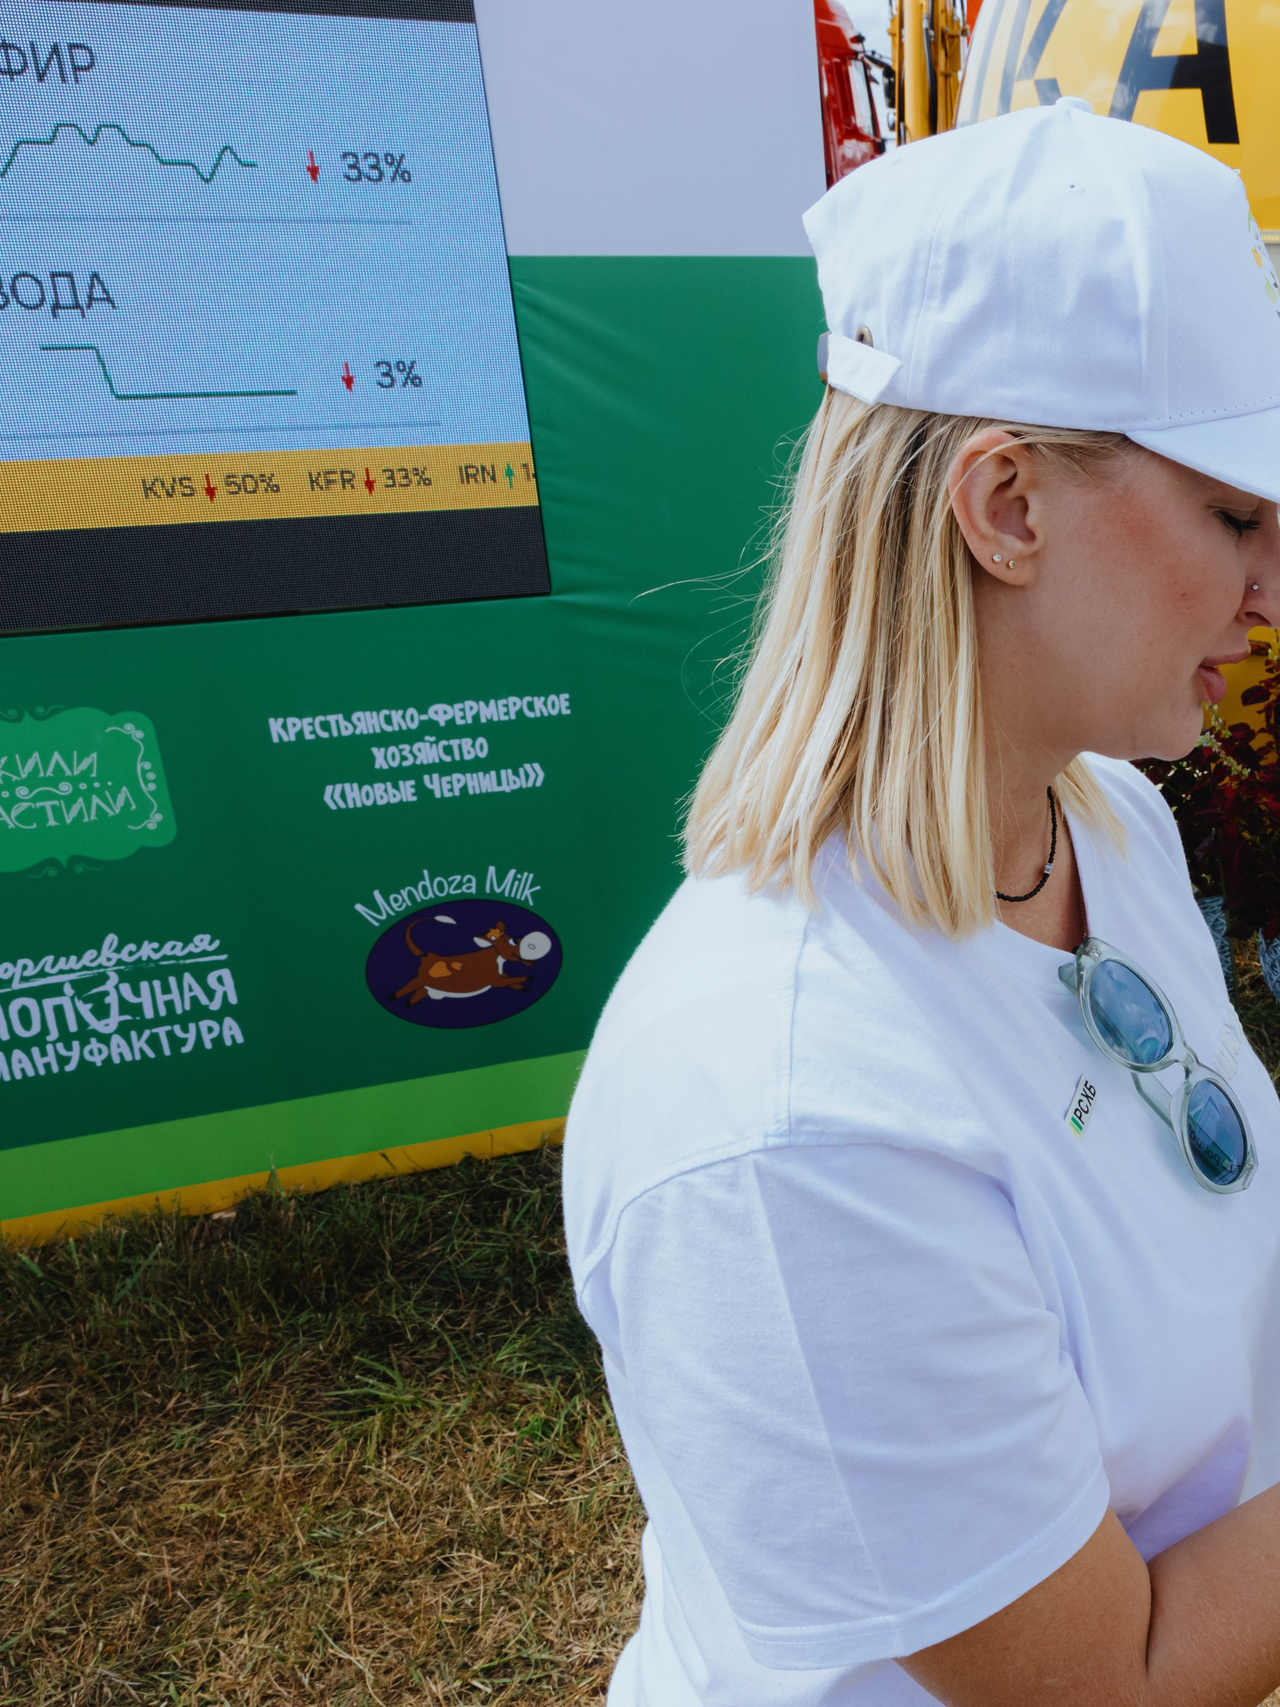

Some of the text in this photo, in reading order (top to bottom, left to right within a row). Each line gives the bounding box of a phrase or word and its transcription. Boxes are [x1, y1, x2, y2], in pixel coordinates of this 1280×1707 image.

[341, 151, 412, 184] 33%
[374, 360, 423, 389] 3%
[142, 477, 196, 500] KVS
[224, 473, 280, 497] 50%
[308, 469, 356, 492] KFR
[382, 466, 432, 488] 33%
[458, 463, 497, 484] IRN
[268, 693, 571, 743] КРЕСТЬЯНСКО-ФЕРМЕРСКОЕ
[371, 735, 489, 770] ХОЗЯЙСТВО
[353, 865, 541, 927] Mendoza Milk
[1073, 1079, 1097, 1125] РСХБ
